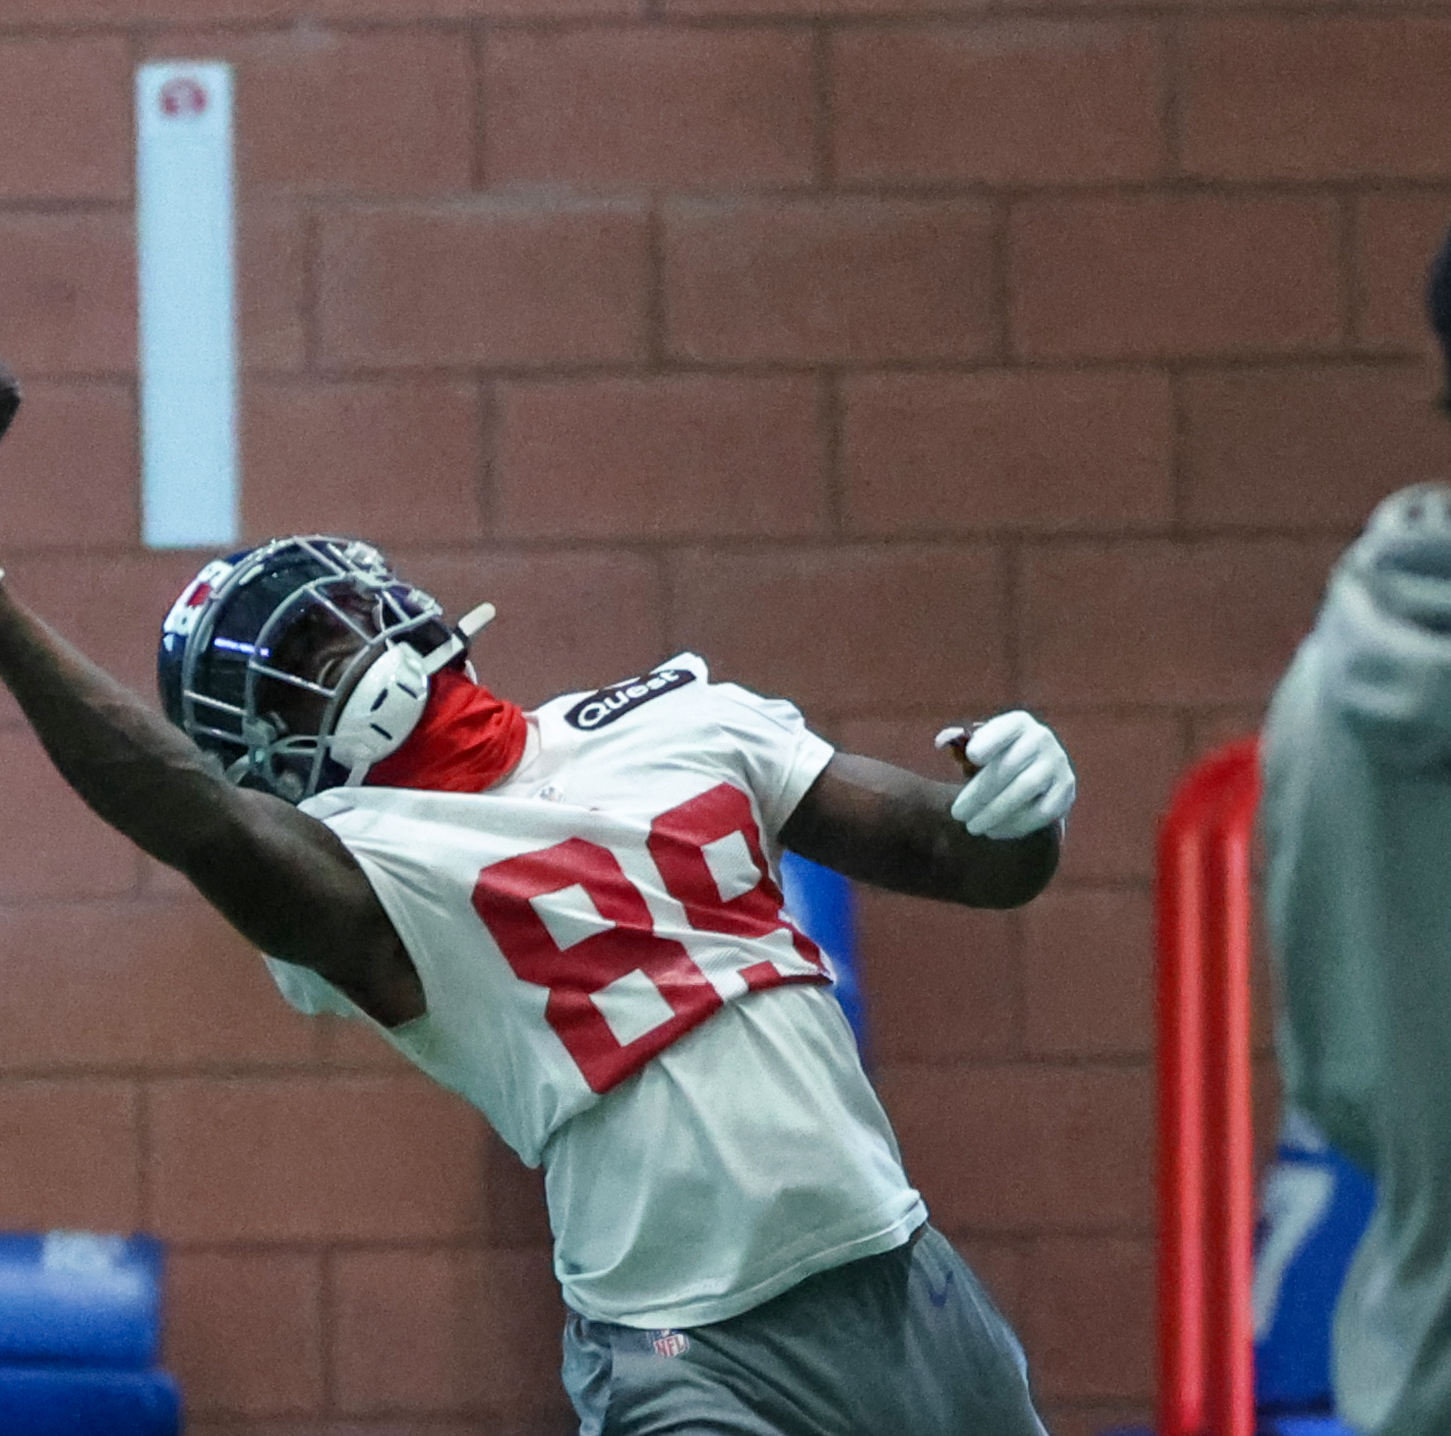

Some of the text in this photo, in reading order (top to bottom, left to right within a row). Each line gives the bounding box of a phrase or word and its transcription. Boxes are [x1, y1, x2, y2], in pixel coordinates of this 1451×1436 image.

[577, 670, 679, 727] Quest
[471, 782, 833, 1094] 89
[653, 1333, 687, 1357] NFL
